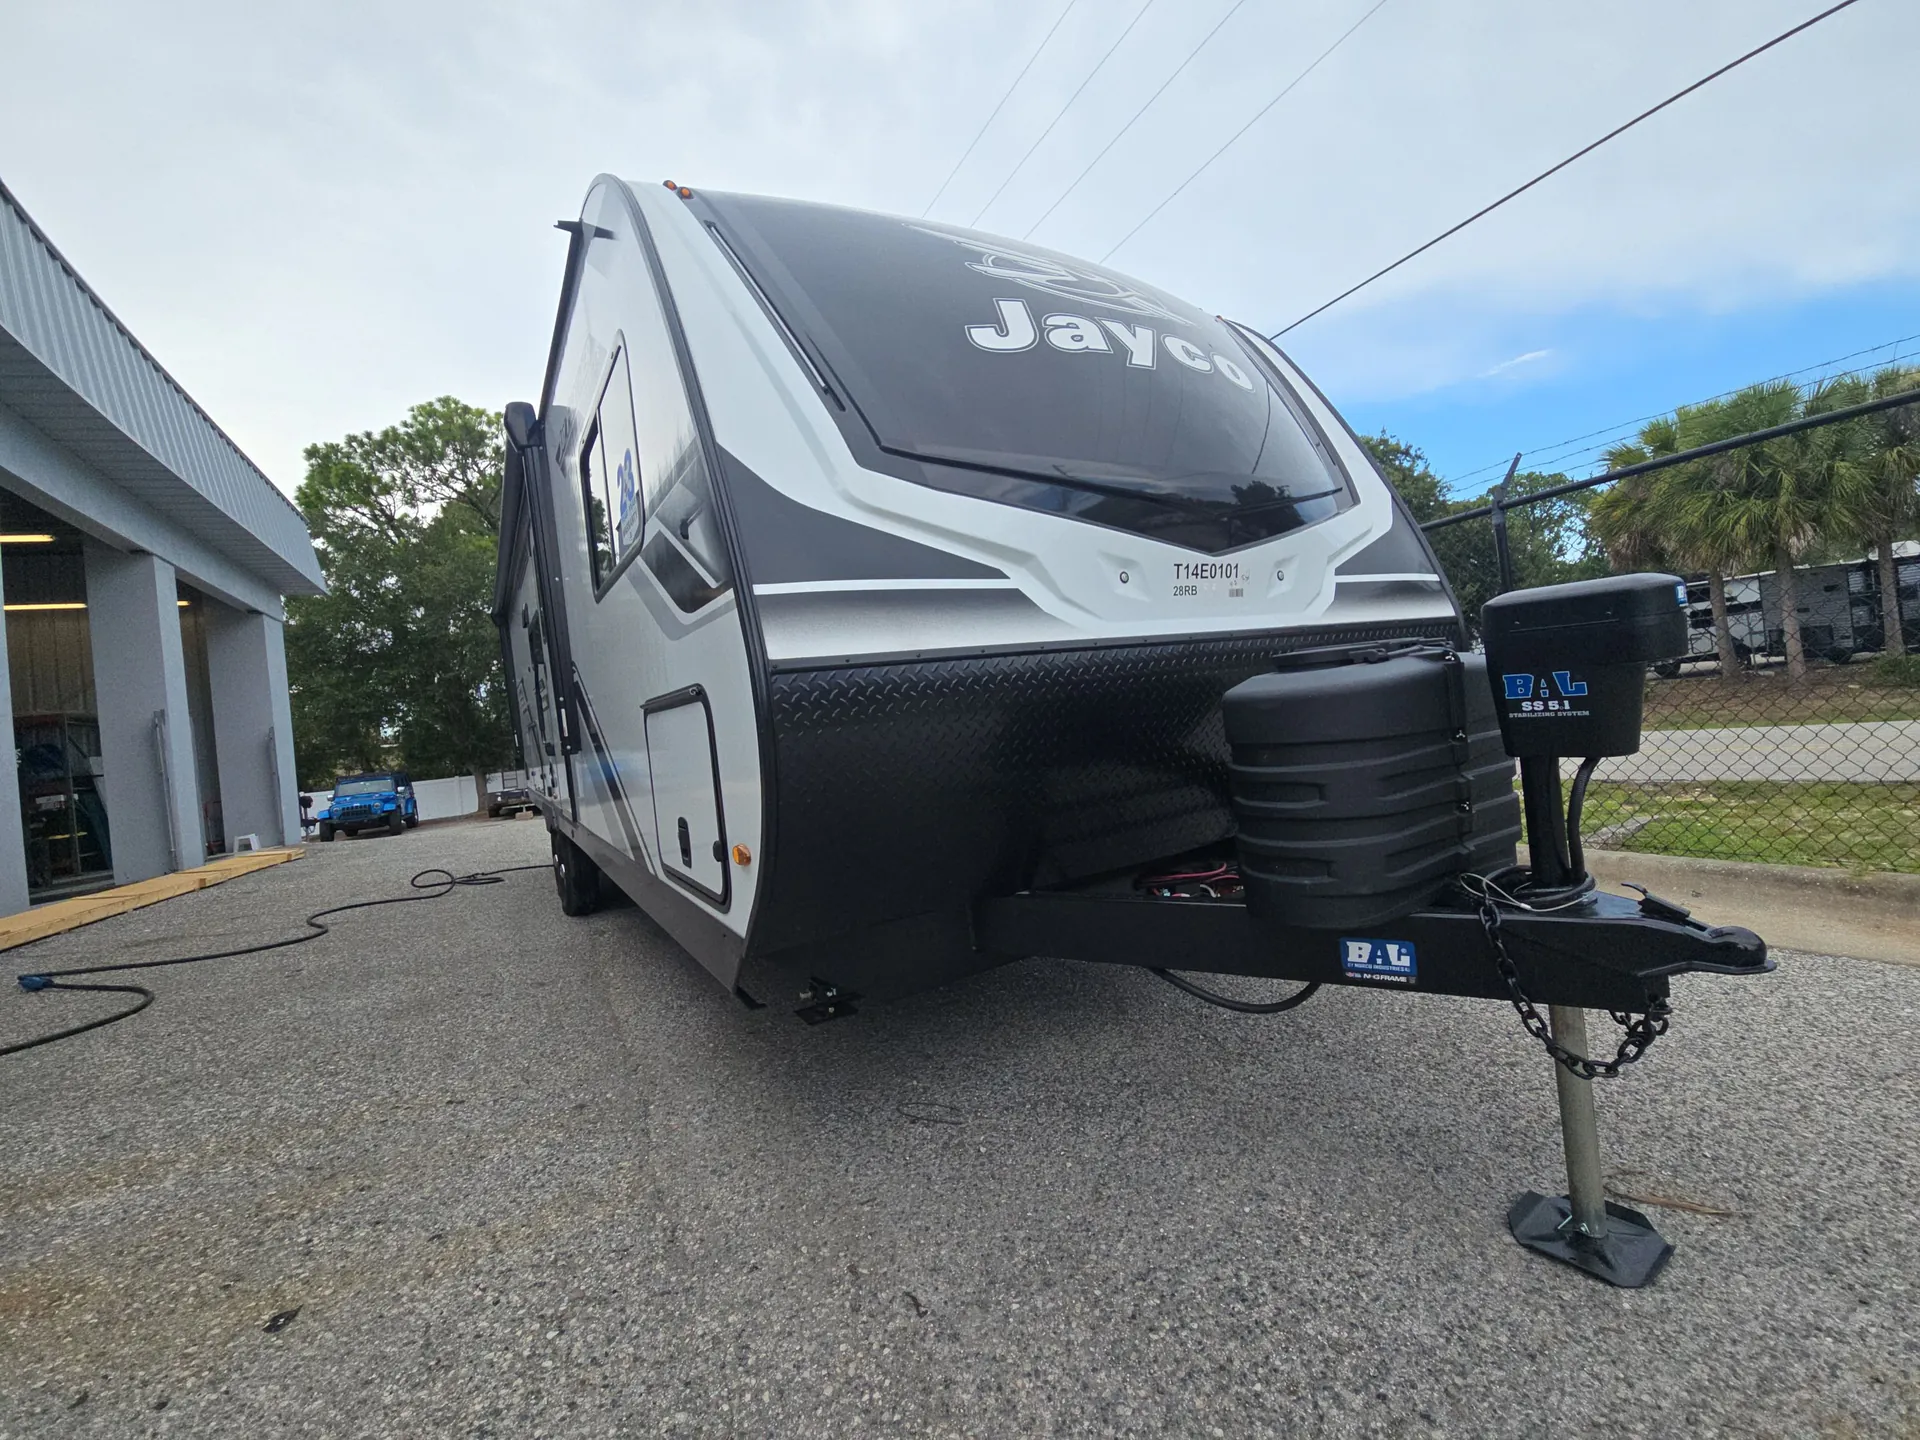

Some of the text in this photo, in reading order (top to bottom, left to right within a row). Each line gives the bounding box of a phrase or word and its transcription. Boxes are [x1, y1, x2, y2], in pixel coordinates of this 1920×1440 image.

[964, 297, 1256, 393] Jayco
[1173, 563, 1239, 579] T14E0101
[1173, 585, 1198, 596] 28RB
[1502, 670, 1588, 699] BAL
[1521, 701, 1544, 711] SS
[1346, 941, 1411, 967] BAL
